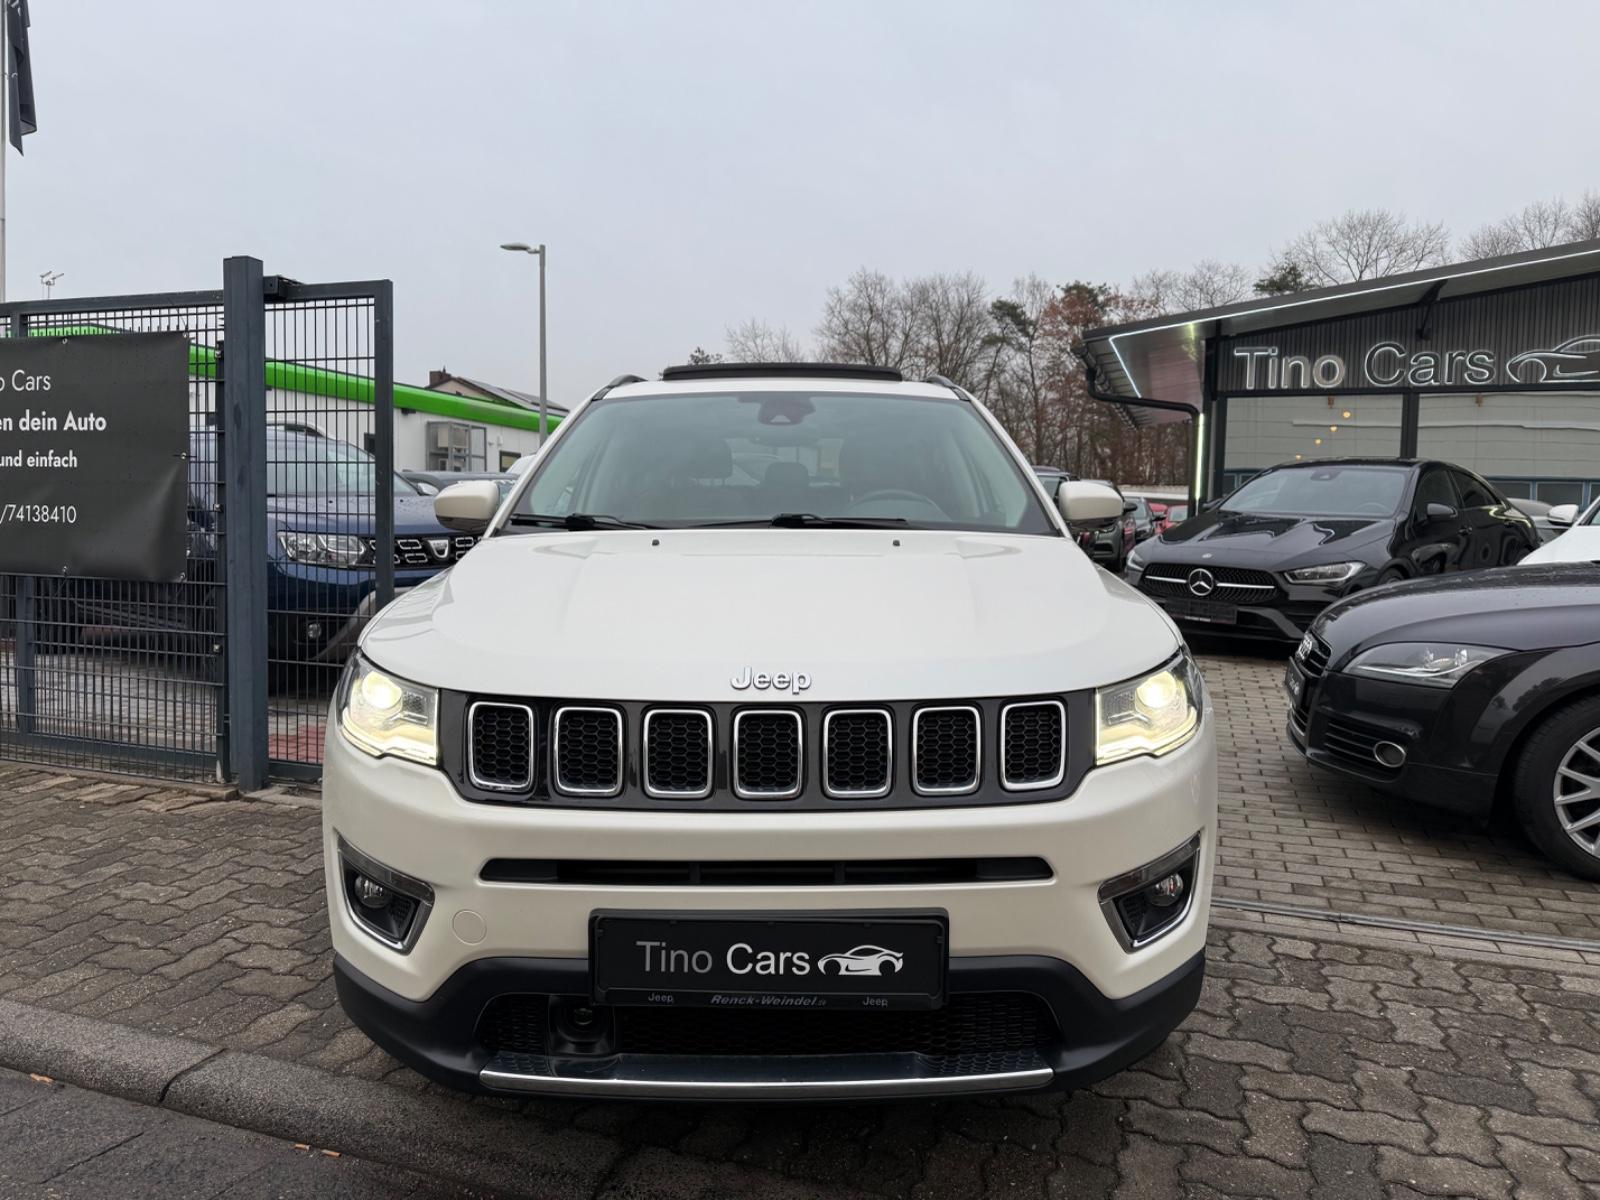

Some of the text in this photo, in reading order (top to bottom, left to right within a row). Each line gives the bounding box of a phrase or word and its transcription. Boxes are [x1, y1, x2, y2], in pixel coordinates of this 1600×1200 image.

[1234, 341, 1497, 390] Tino Cars
[11, 369, 51, 391] Cars
[19, 409, 57, 431] dein
[63, 411, 107, 431] Auto
[27, 450, 78, 468] einfach
[730, 664, 812, 695] Jeep
[636, 941, 811, 976] Tino Cars
[648, 992, 675, 1004] Jeep
[862, 996, 888, 1007] Jeep
